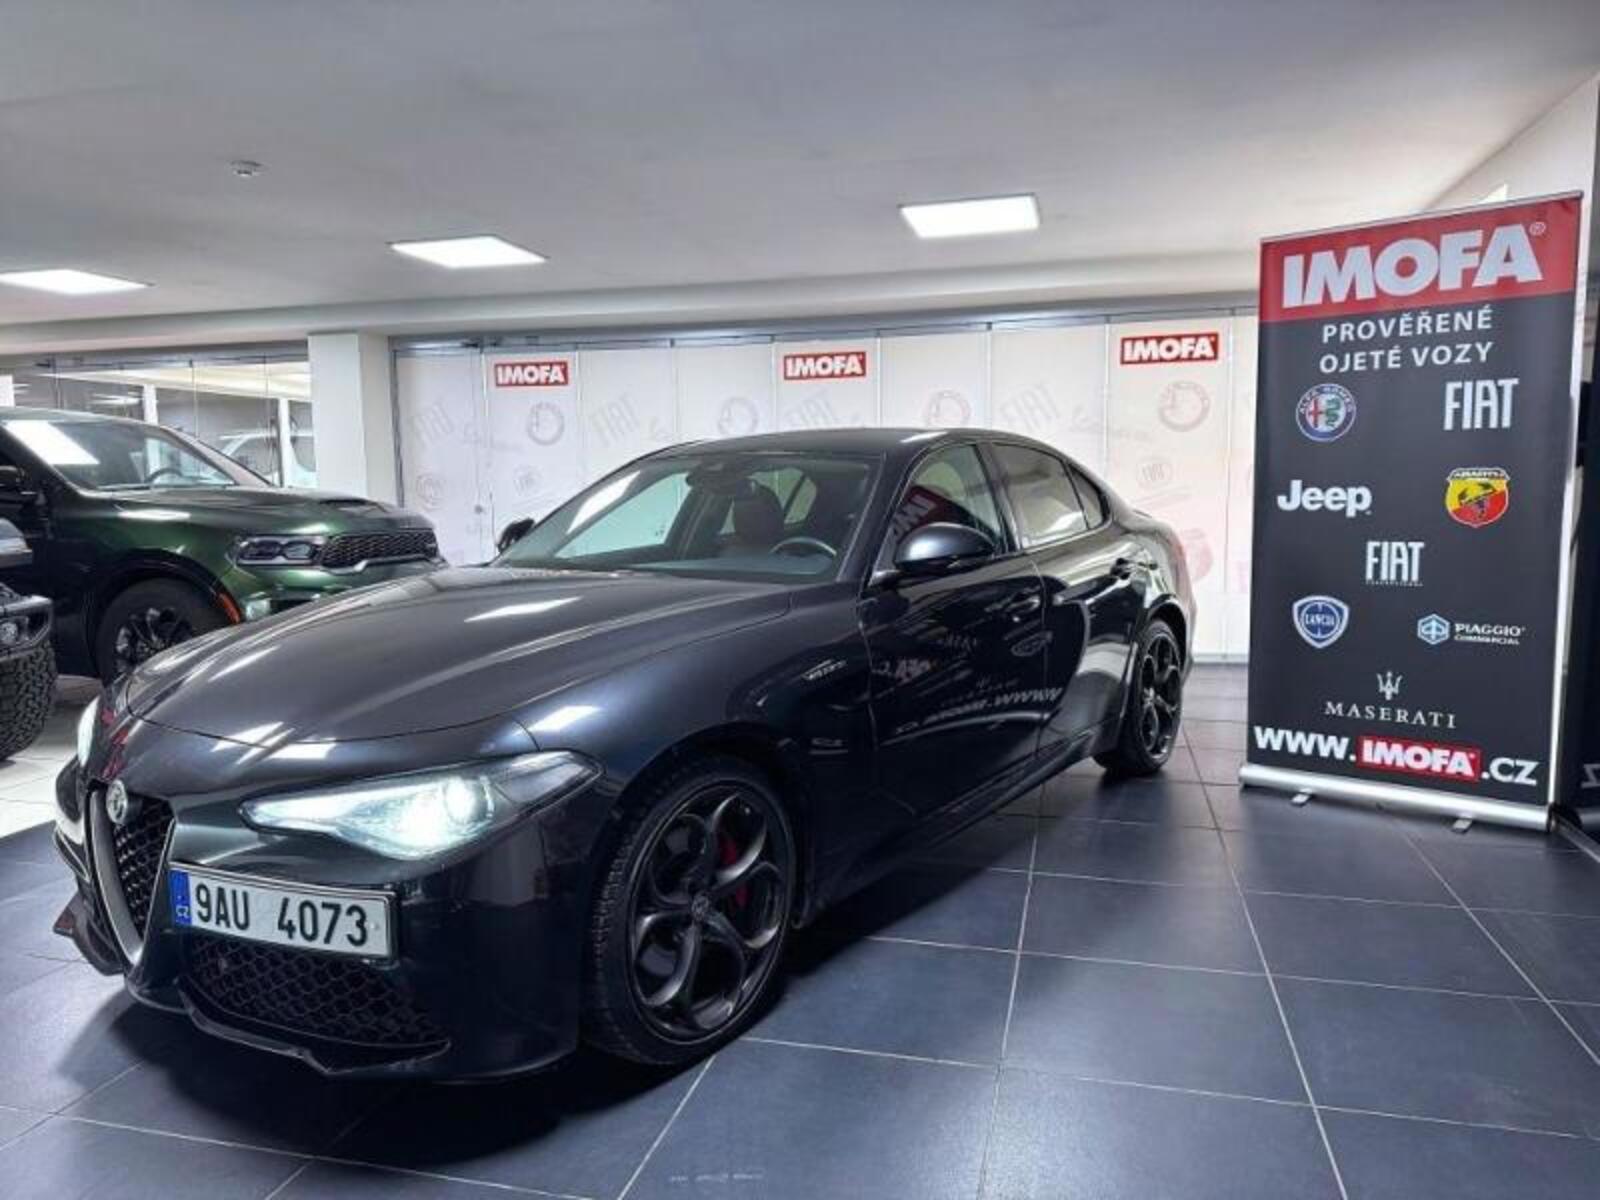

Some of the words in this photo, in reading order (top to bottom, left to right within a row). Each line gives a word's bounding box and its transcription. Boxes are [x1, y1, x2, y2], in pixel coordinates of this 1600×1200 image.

[1322, 306, 1493, 343] PROVĚŘENÉ
[1319, 345, 1401, 373] OJETÉ
[1412, 341, 1493, 367] VOZY
[1443, 378, 1519, 431] FIAT
[1277, 480, 1372, 518] Jeep
[1366, 541, 1425, 582] FIAT
[1454, 622, 1521, 638] PIAGGIO
[1325, 701, 1457, 729] MASERATI
[195, 882, 250, 931] 9AU
[277, 897, 368, 948] 4073
